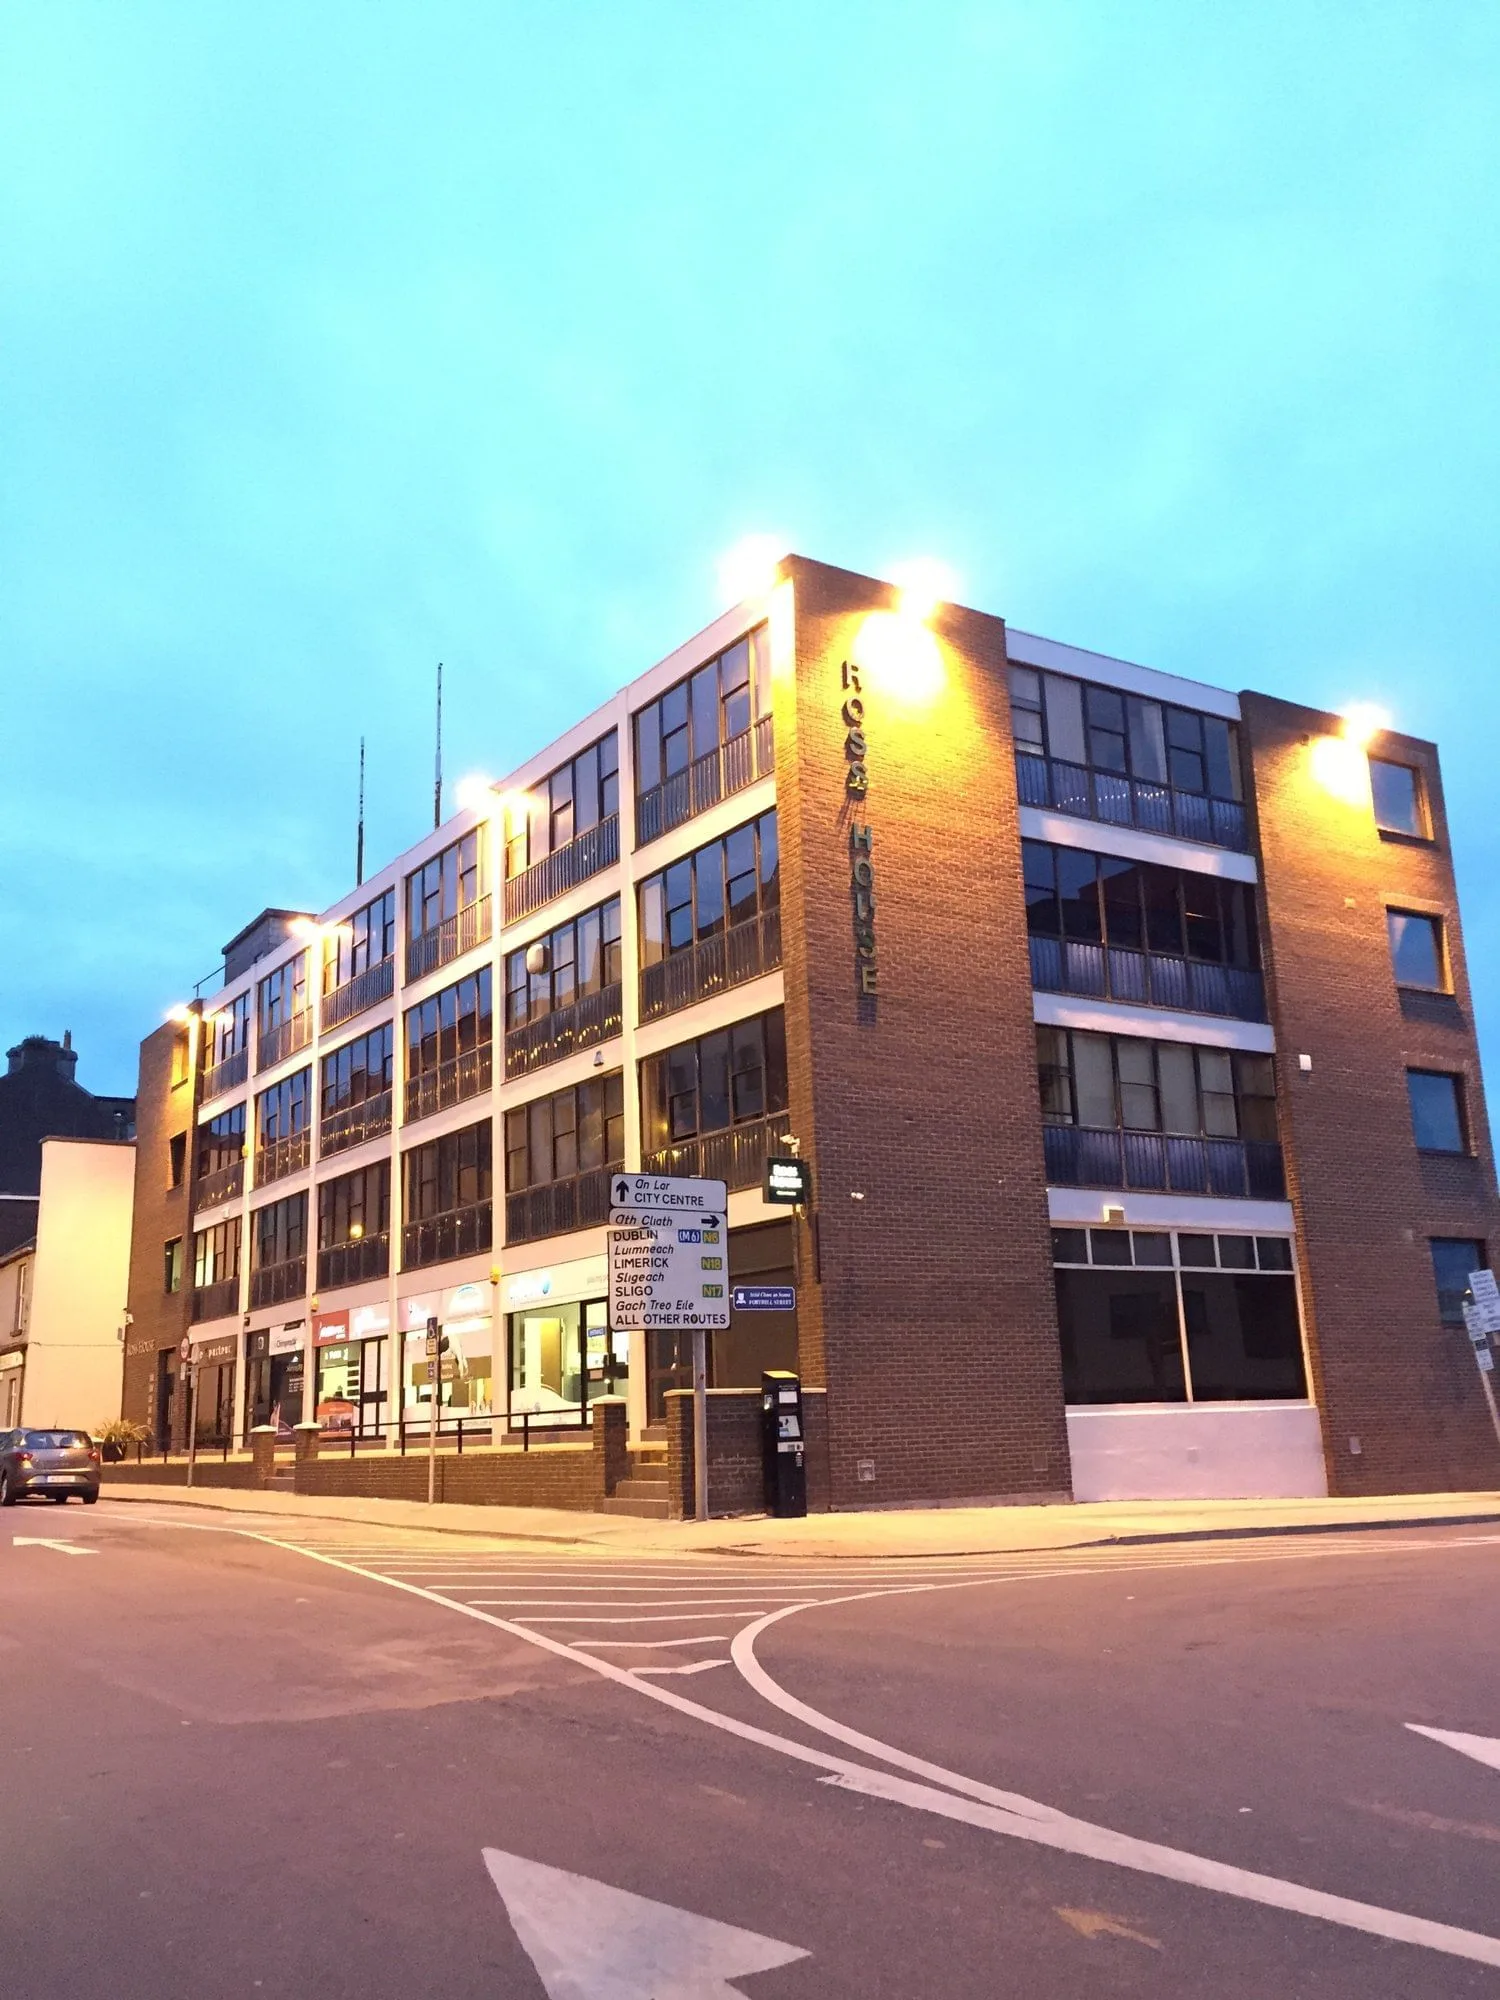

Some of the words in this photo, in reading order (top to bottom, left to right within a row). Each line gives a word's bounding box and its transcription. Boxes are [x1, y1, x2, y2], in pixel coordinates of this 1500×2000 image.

[853, 822, 878, 995] HOUSE
[635, 1178, 650, 1190] An
[634, 1192, 660, 1203] CITY
[662, 1194, 704, 1206] CENTRE
[641, 1215, 673, 1227] Cliath
[613, 1230, 658, 1242] DUBLIN
[614, 1245, 674, 1256] Luimneach
[614, 1257, 669, 1269] LIMERICK
[702, 1258, 721, 1269] N18
[615, 1272, 665, 1285] Sligeach
[615, 1286, 653, 1297] SLIGO
[703, 1285, 722, 1296] N17
[615, 1301, 646, 1311] Gach
[650, 1300, 672, 1310] Treo
[676, 1301, 694, 1310] Eile
[615, 1315, 639, 1325] ALL
[643, 1314, 680, 1324] OTHER
[683, 1314, 726, 1324] ROUTES
